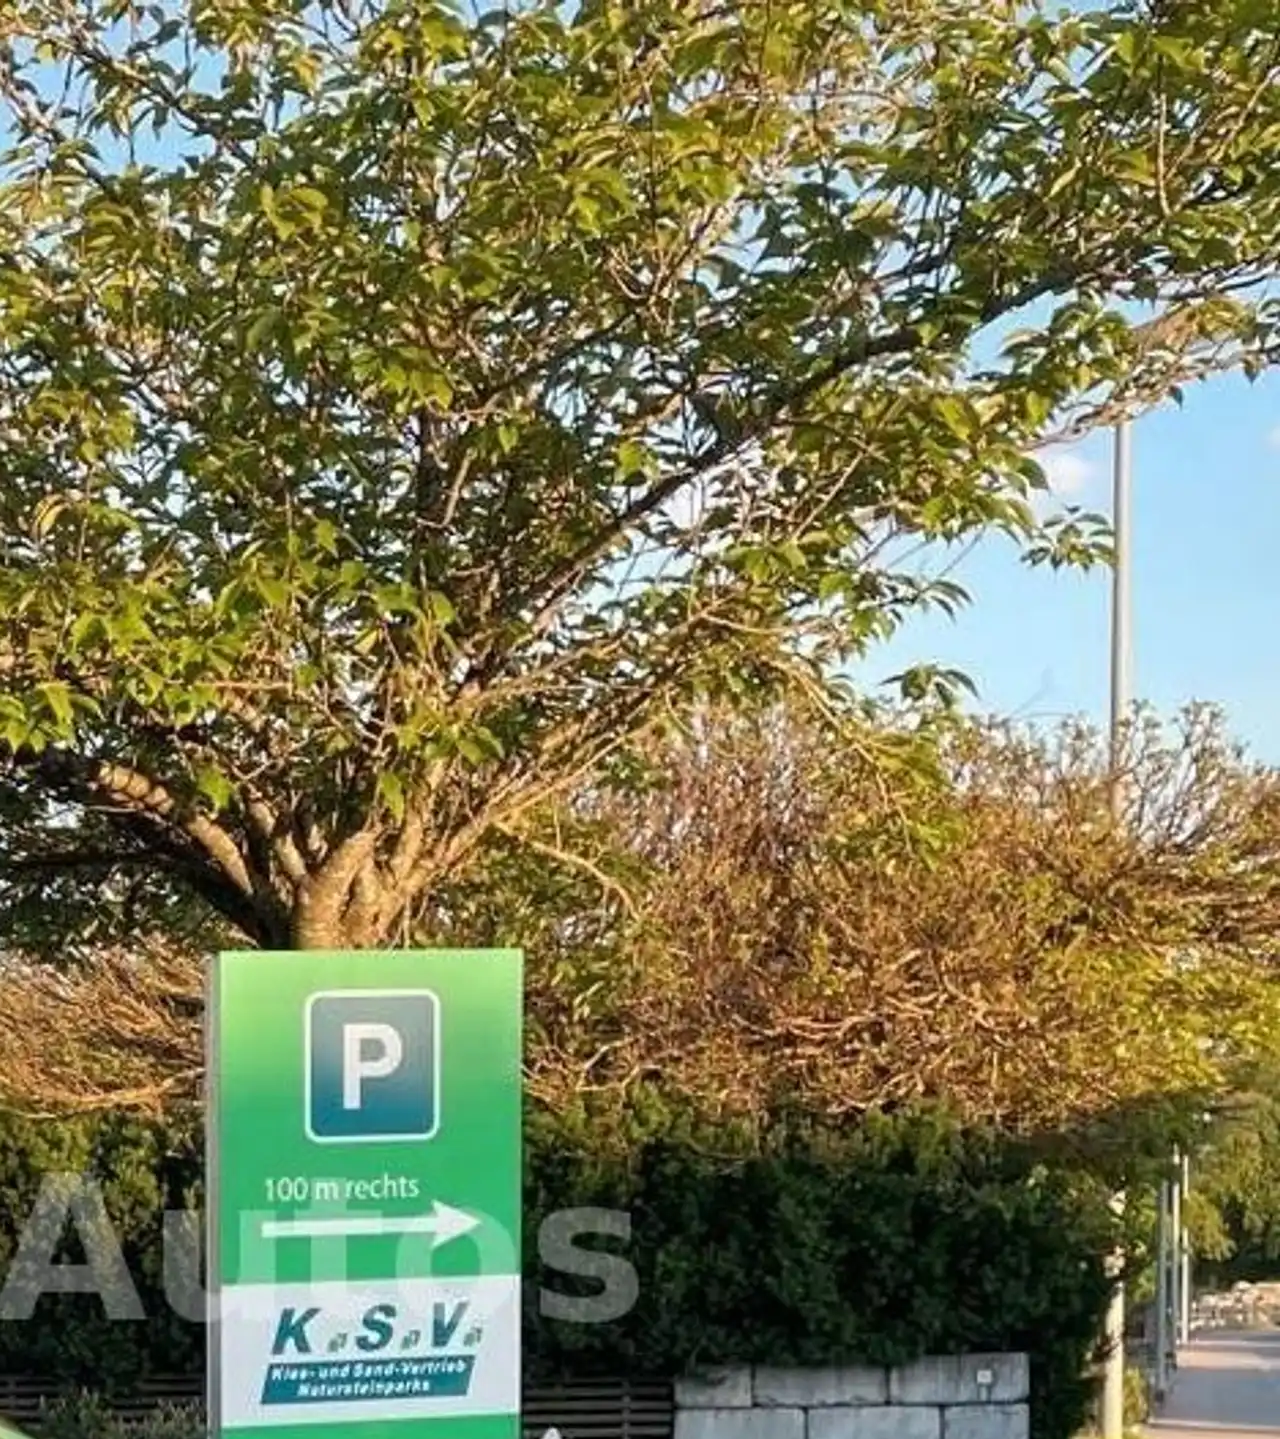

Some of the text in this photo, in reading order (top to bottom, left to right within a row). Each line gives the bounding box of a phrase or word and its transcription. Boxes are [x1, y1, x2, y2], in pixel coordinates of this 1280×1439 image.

[342, 1022, 403, 1110] P
[265, 1174, 420, 1201] 100 m rechts
[297, 1379, 431, 1397] Natursteinparks
